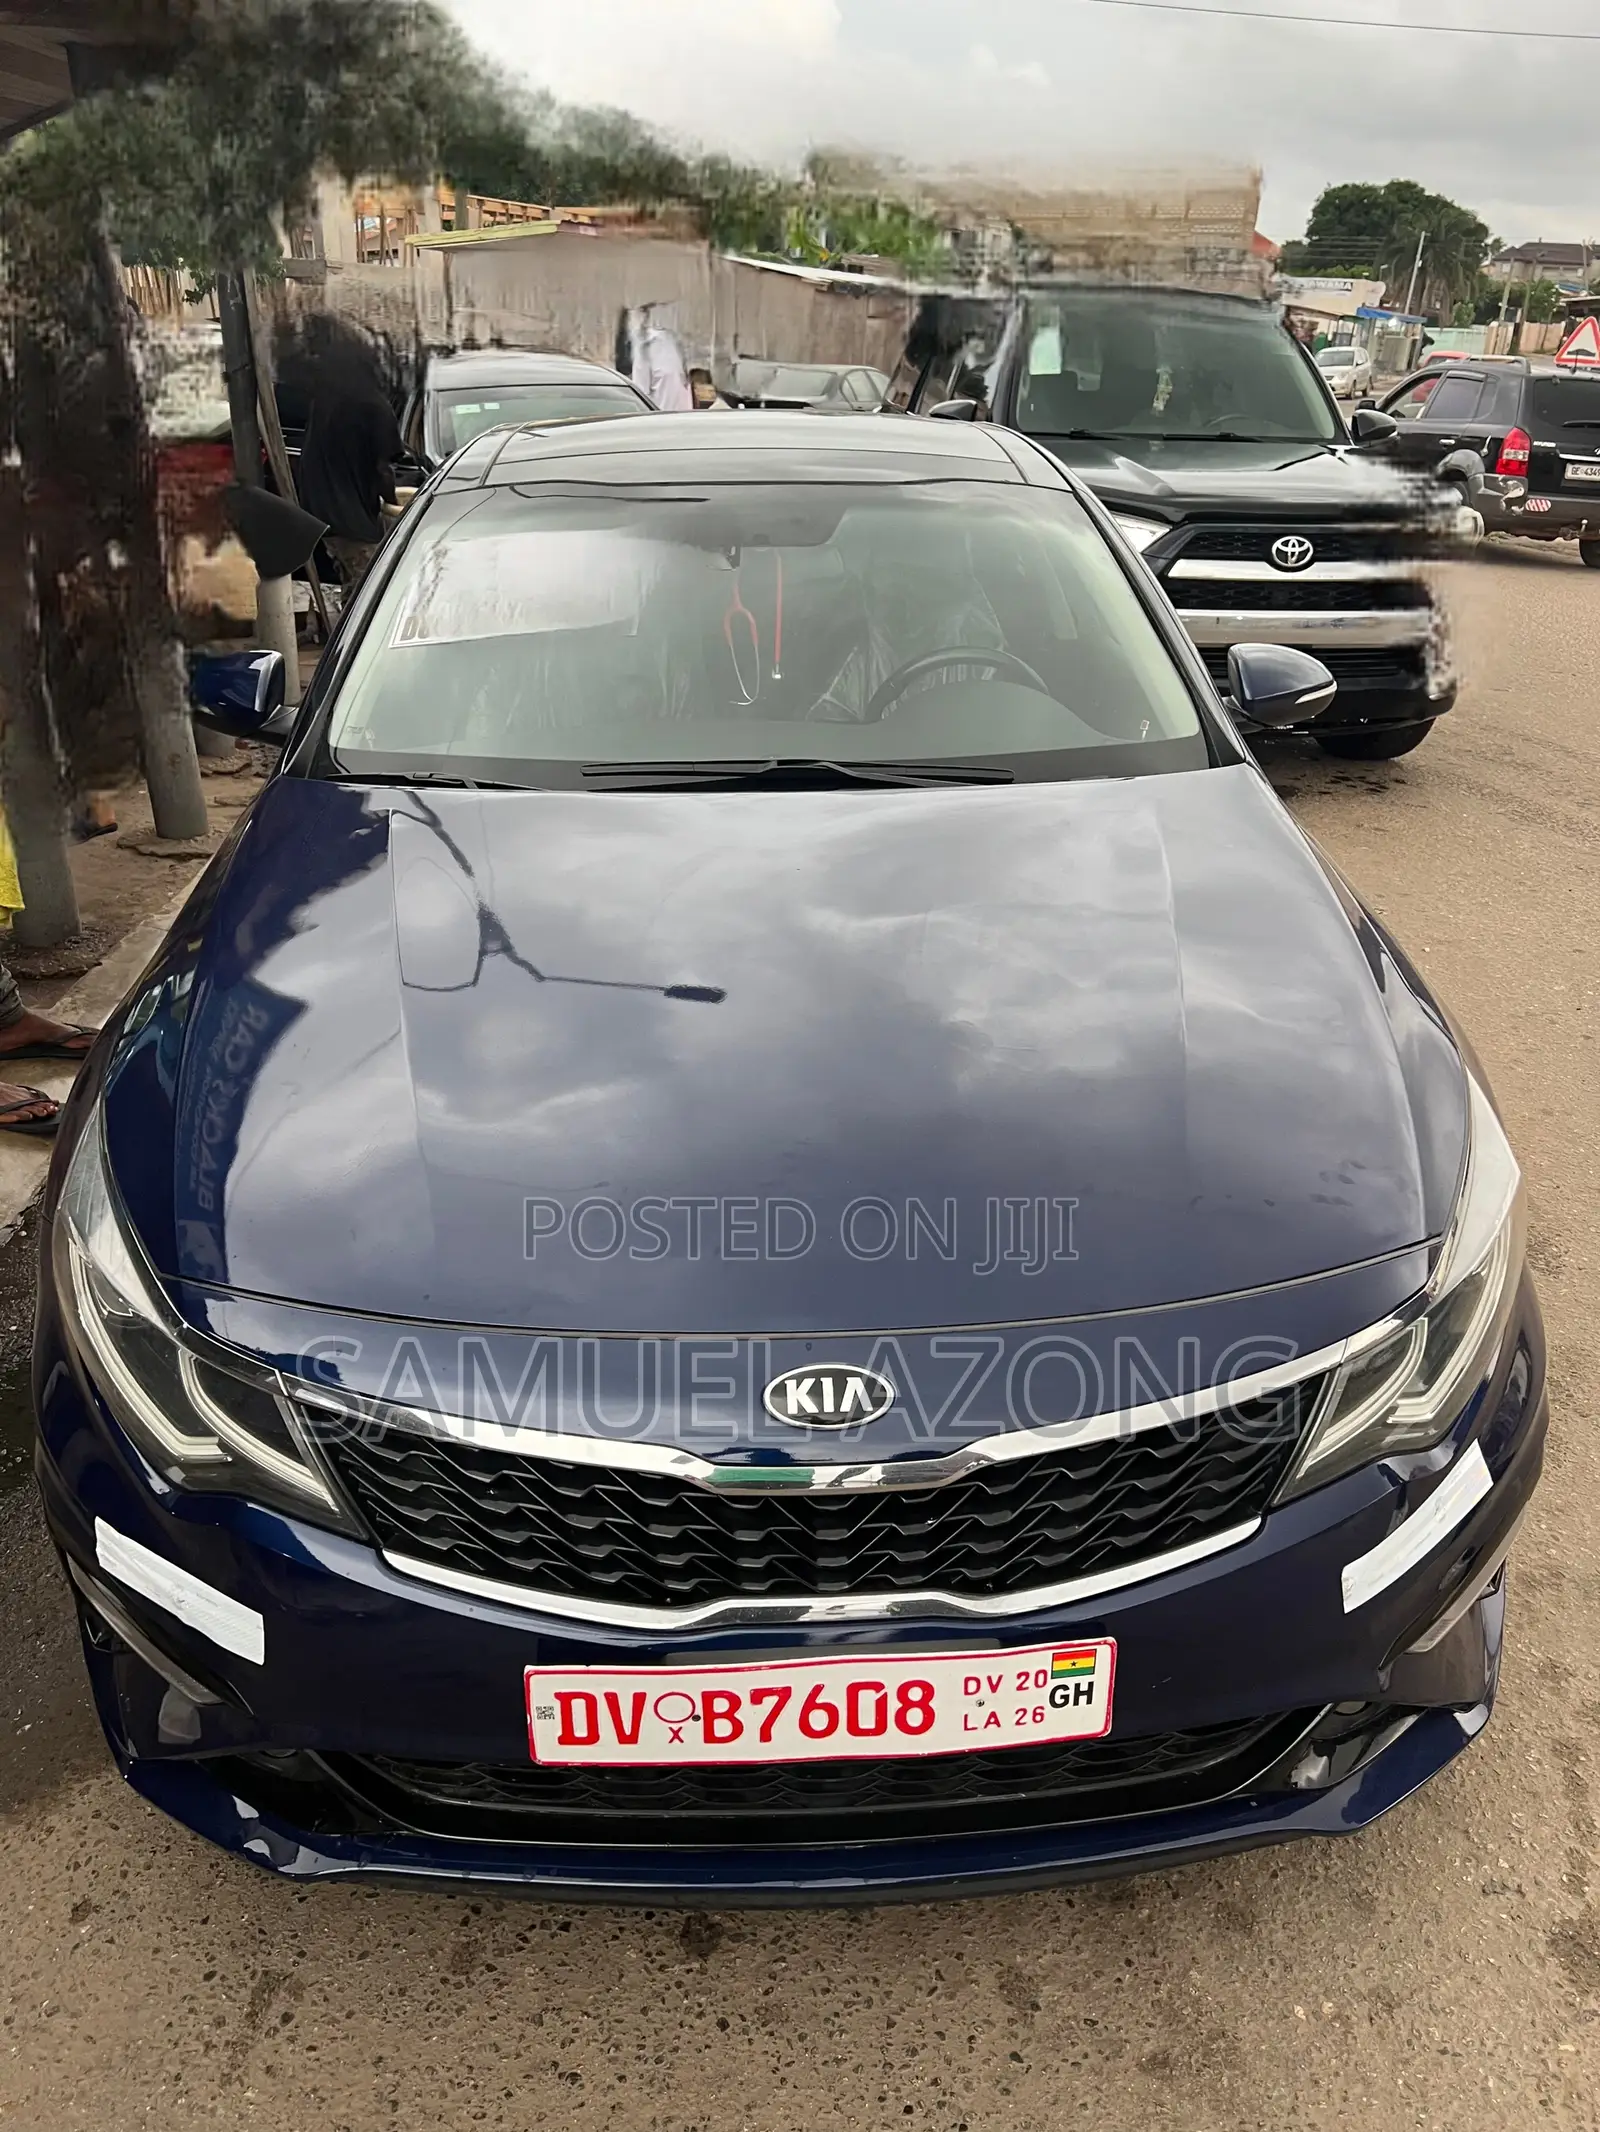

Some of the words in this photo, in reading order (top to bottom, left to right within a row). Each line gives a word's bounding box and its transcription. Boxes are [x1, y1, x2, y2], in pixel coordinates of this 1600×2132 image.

[786, 1378, 874, 1416] KIA
[963, 1674, 1003, 1696] DV
[1015, 1669, 1048, 1691] 20
[1049, 1681, 1095, 1709] GH
[554, 1691, 648, 1745] DV
[700, 1679, 936, 1744] B7608
[963, 1711, 1002, 1731] LA
[1014, 1706, 1045, 1726] 26
